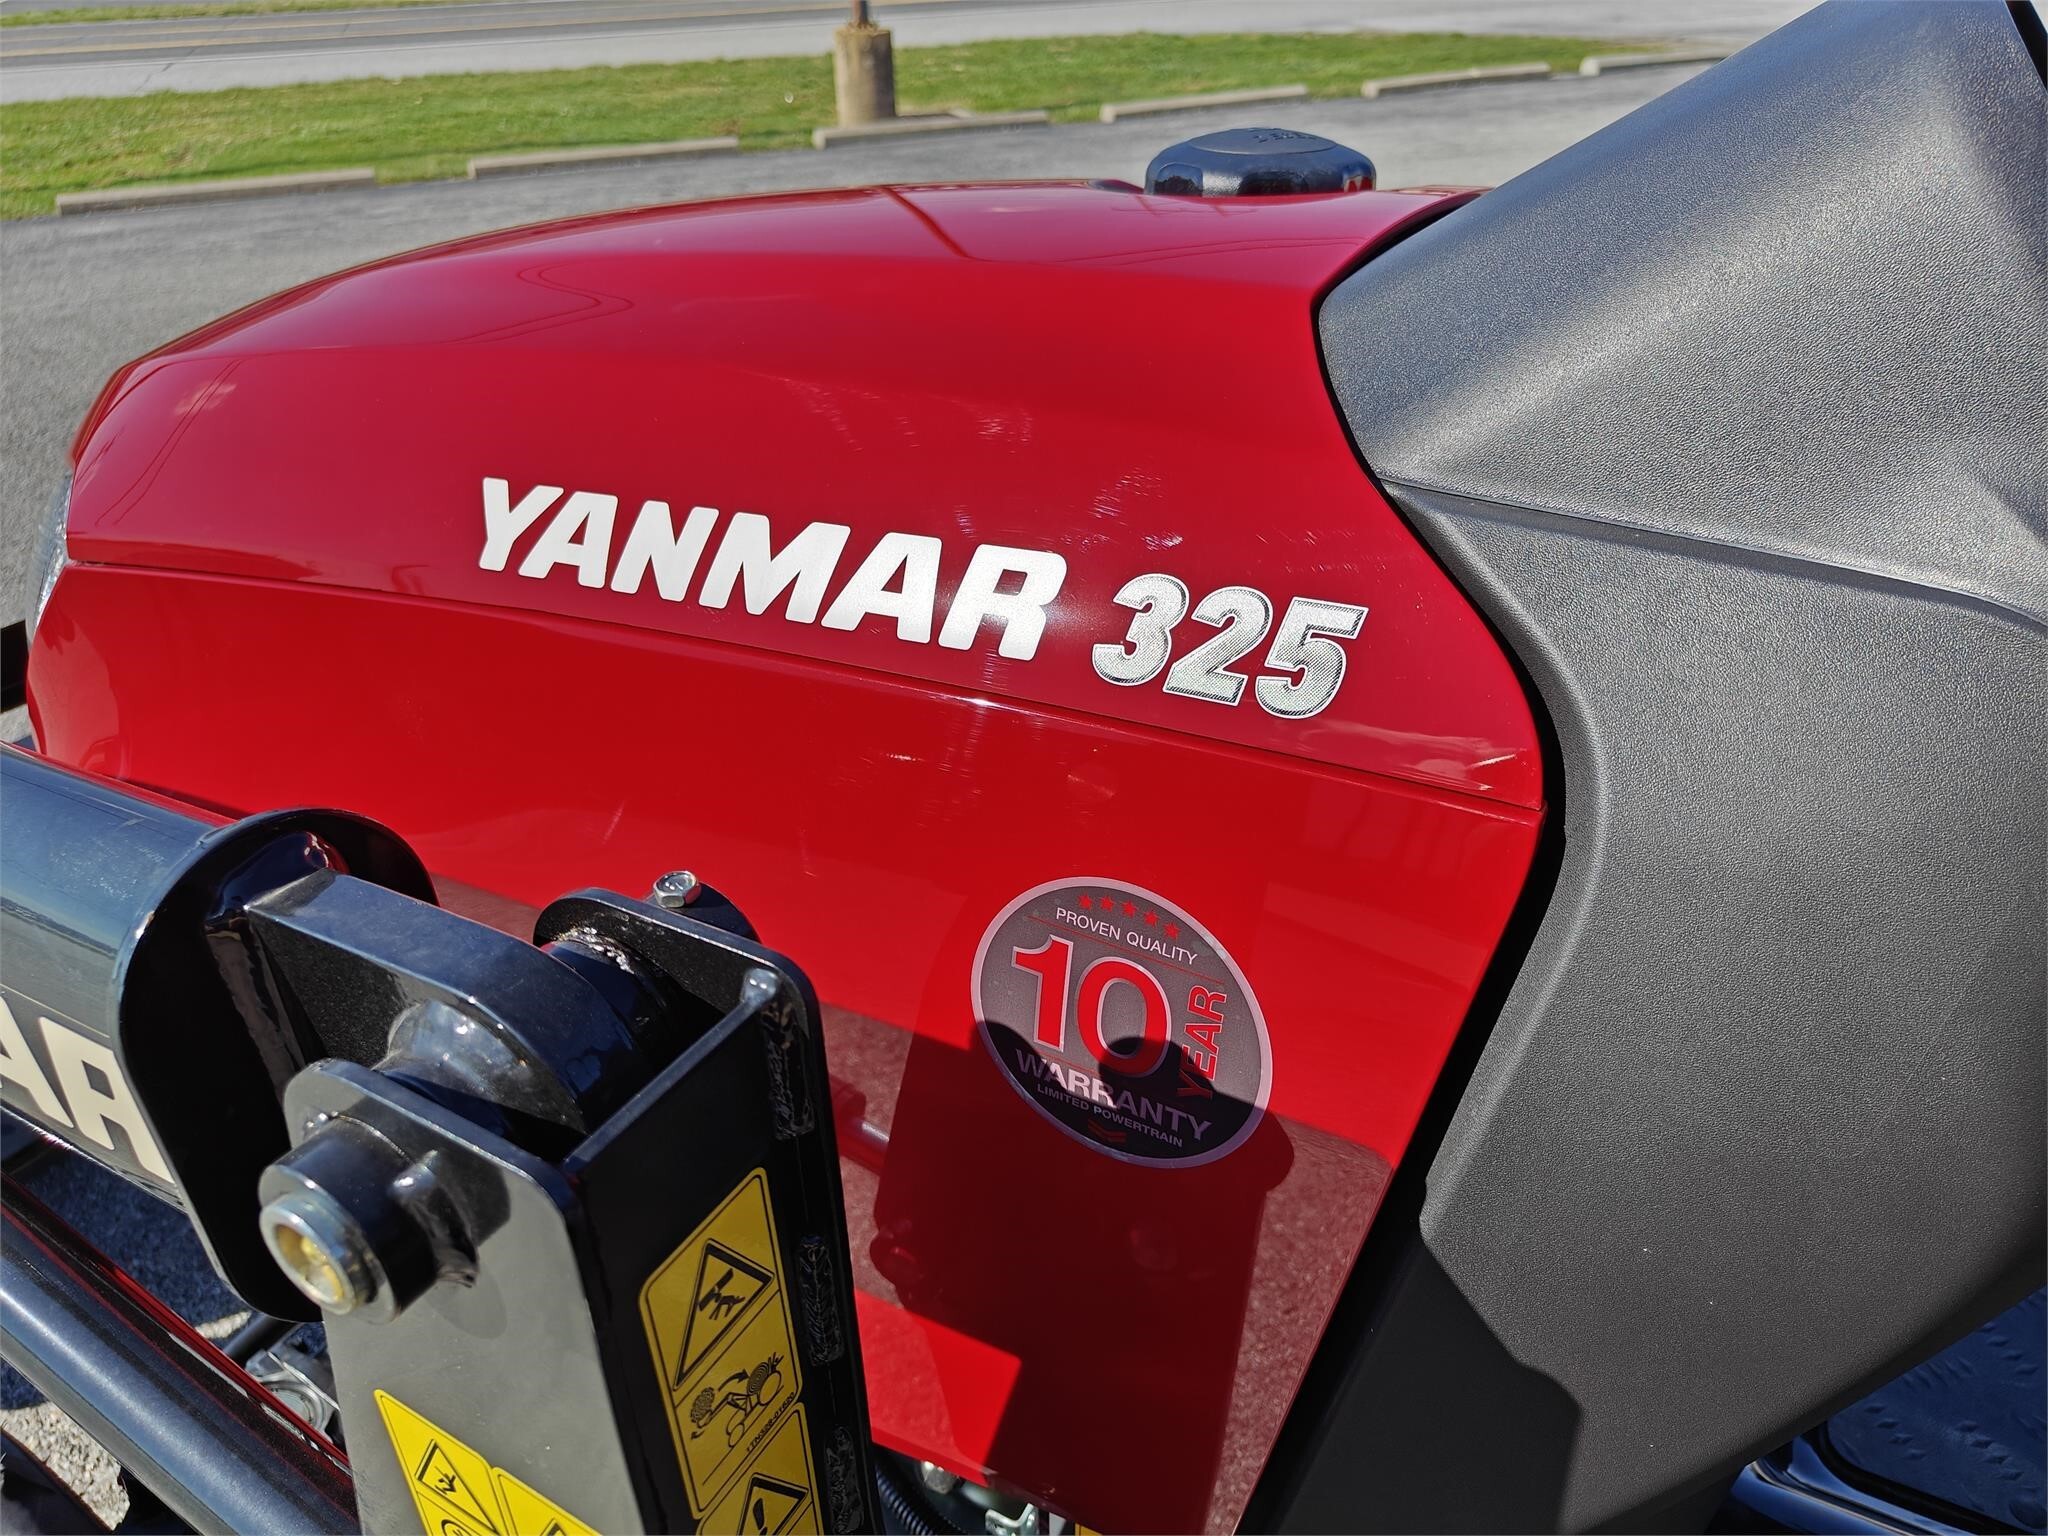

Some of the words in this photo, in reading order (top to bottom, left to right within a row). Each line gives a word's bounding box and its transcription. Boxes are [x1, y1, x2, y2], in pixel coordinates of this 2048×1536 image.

[480, 477, 1068, 661] YANMAR
[1091, 573, 1369, 720] 325
[1055, 906, 1121, 941] PROVEN
[1126, 931, 1198, 965] QUALITY
[1011, 933, 1172, 1076] 10
[1176, 984, 1228, 1100] YEAR
[1015, 1048, 1213, 1141] WARRANTY
[1036, 1083, 1090, 1111] LIMITED
[1093, 1105, 1184, 1148] POWERTRAIN
